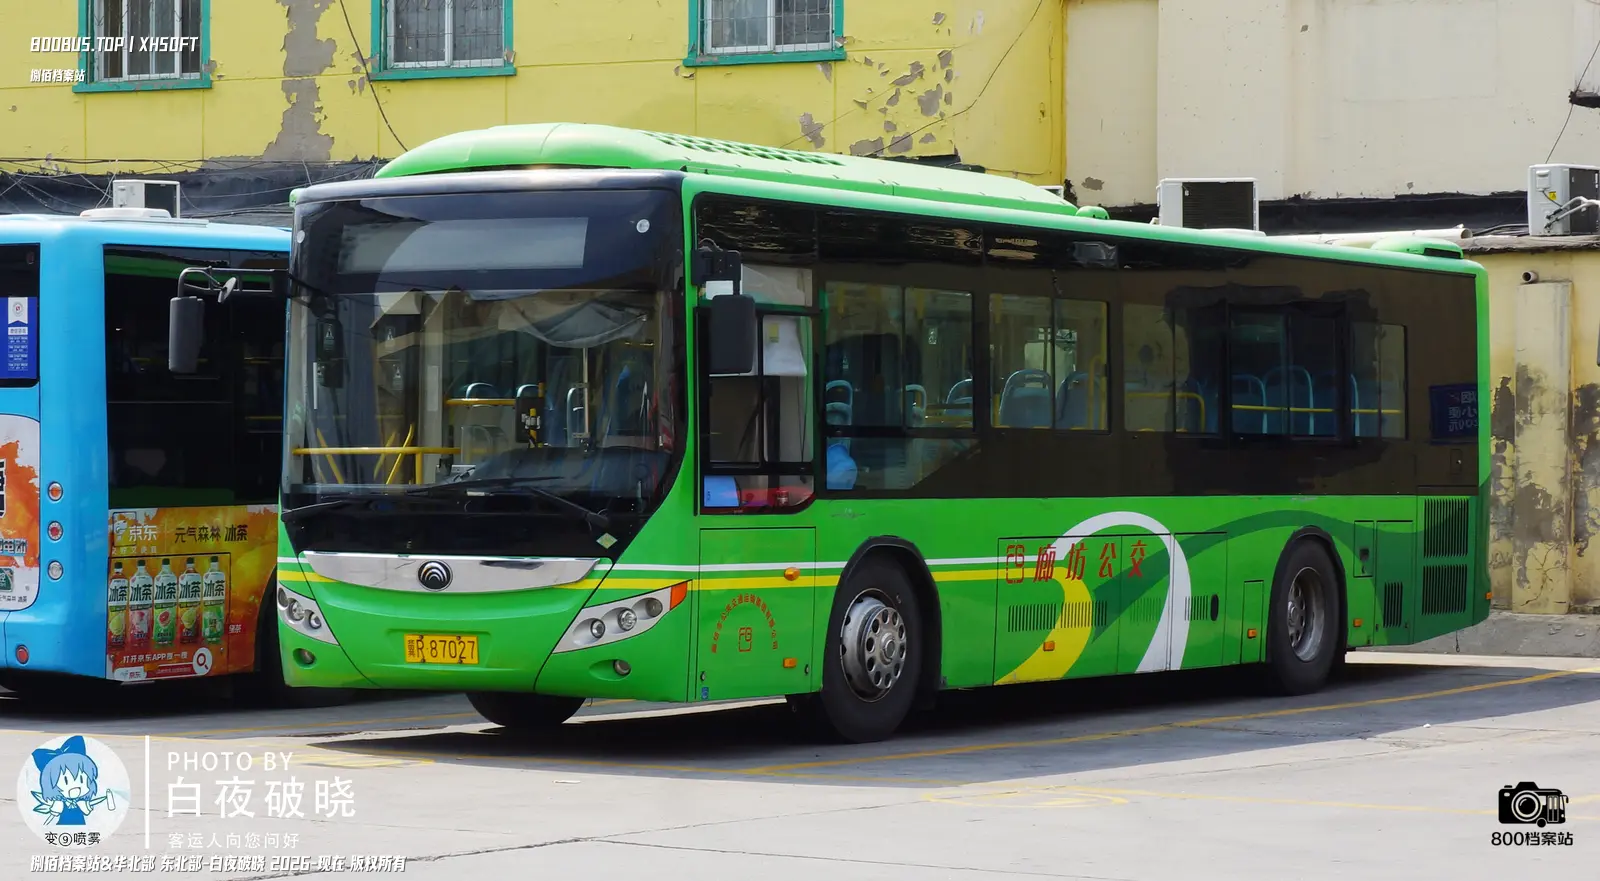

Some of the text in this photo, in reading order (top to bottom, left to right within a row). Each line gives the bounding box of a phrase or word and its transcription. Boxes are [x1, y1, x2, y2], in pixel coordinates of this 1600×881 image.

[129, 524, 249, 543] 京东 元气森林 冰茶
[1033, 540, 1148, 582] 廊坊公交
[130, 584, 153, 601] 冰茶
[155, 582, 177, 600] 冰茶
[179, 581, 201, 599] 冰茶
[204, 579, 225, 598] 冰茶
